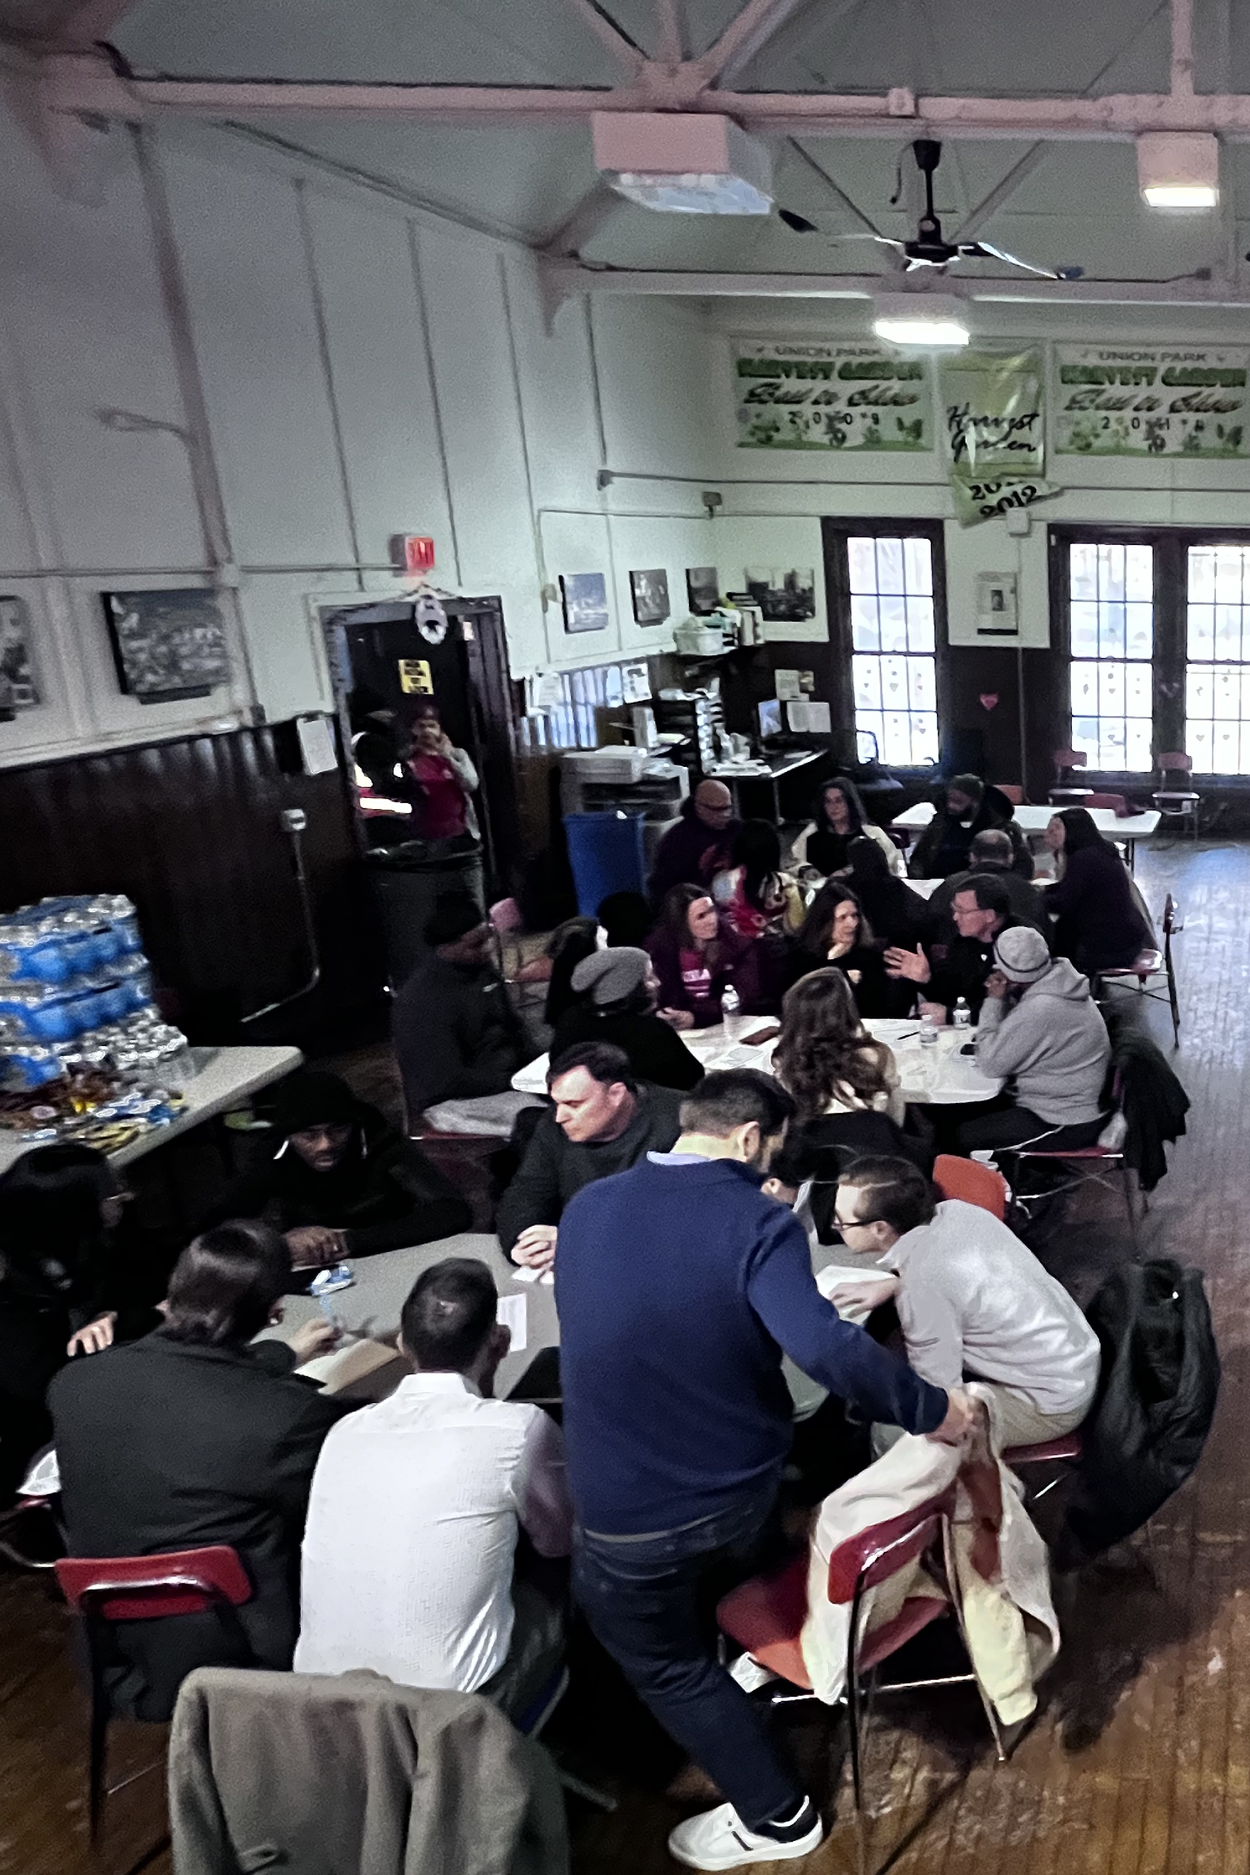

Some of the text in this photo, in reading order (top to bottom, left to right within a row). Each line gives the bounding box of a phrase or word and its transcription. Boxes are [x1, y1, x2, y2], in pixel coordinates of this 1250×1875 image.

[1100, 352, 1207, 362] UNION PARK
[951, 428, 1037, 463] Gaen
